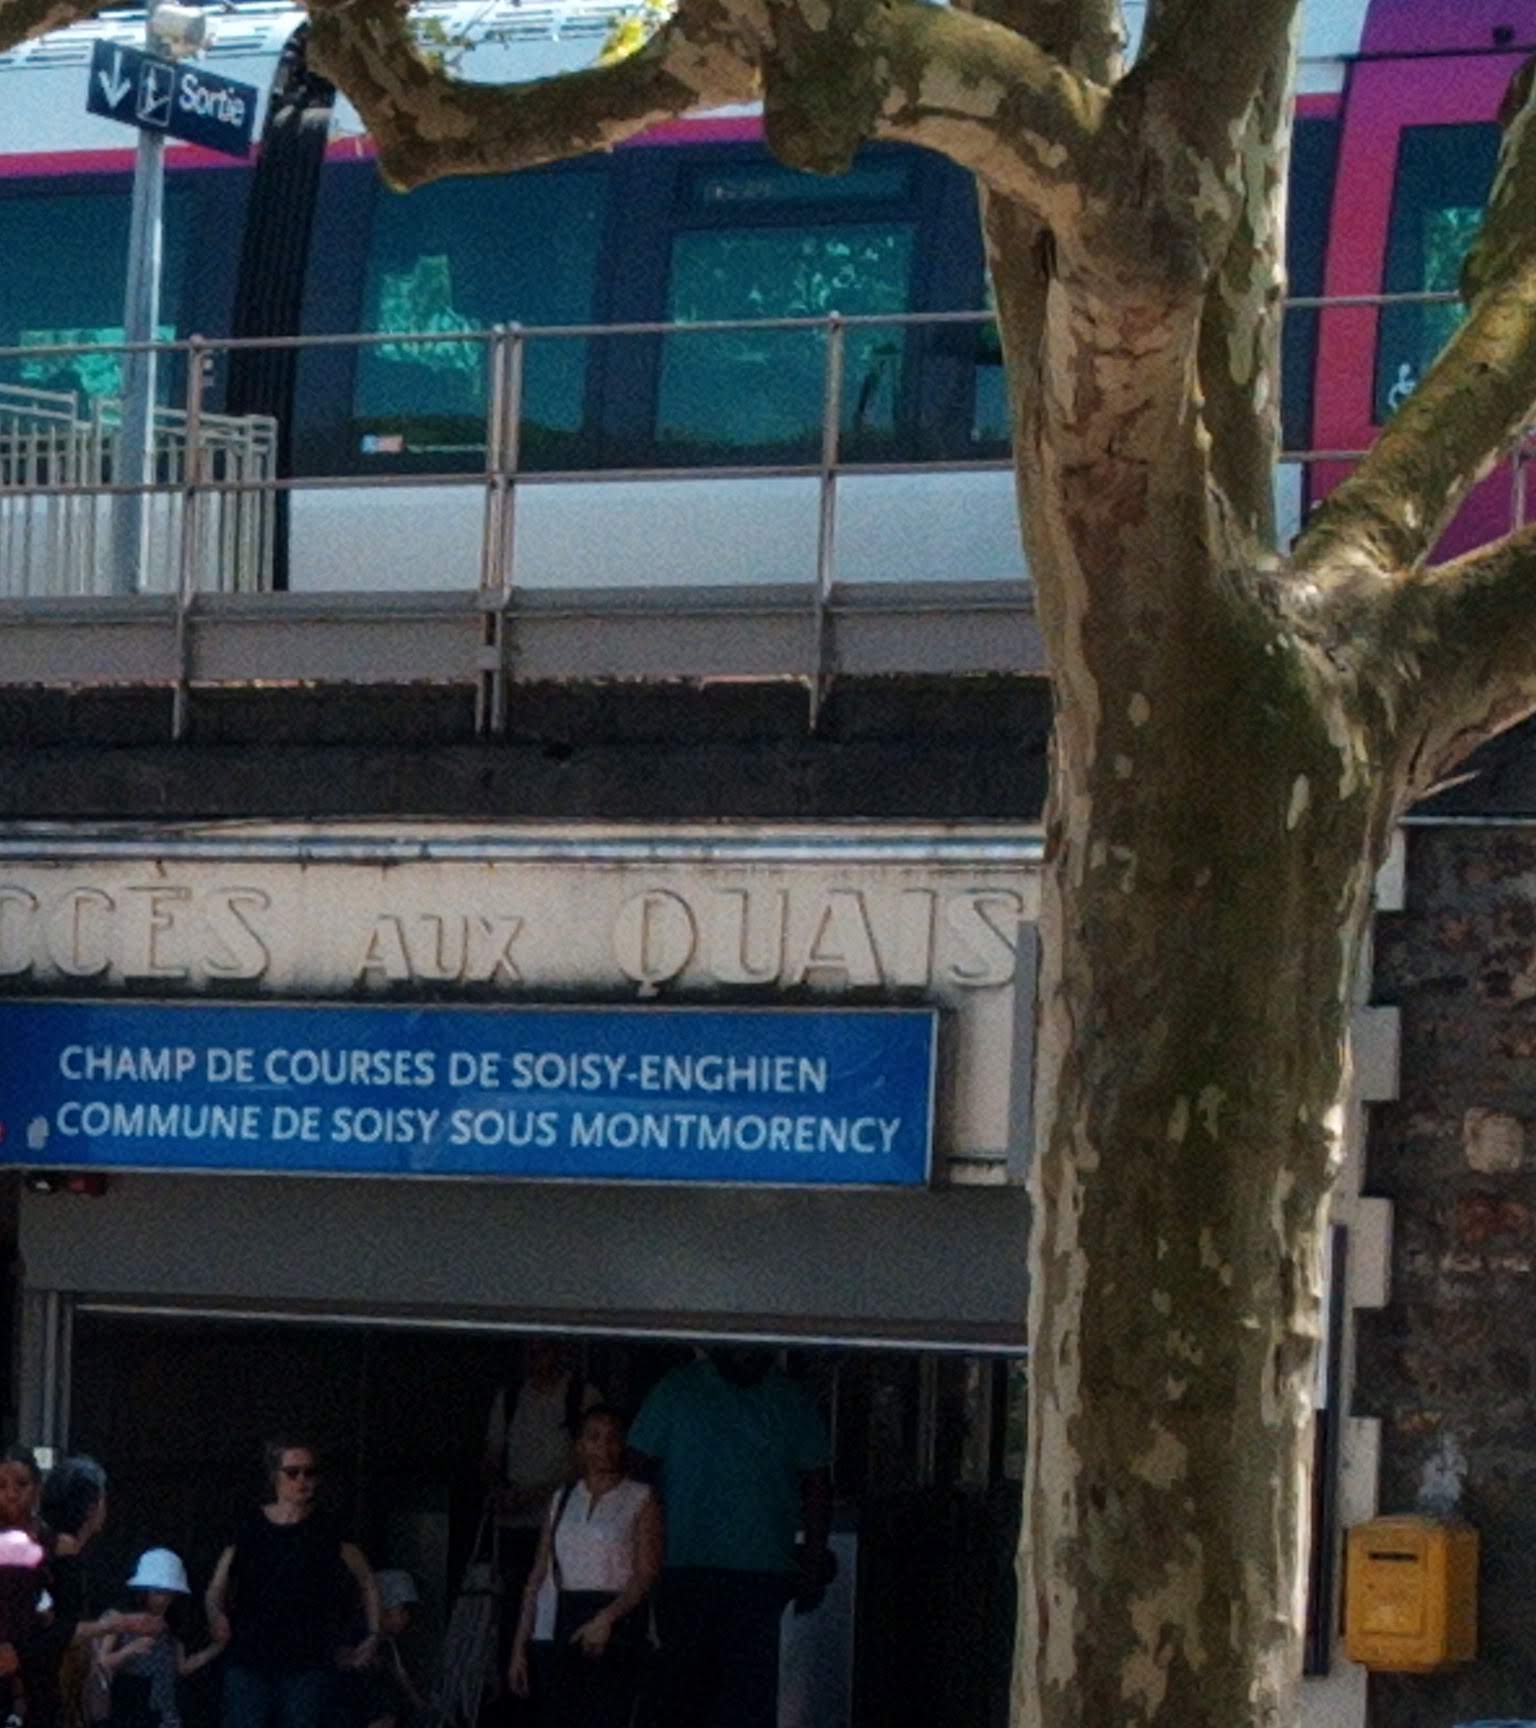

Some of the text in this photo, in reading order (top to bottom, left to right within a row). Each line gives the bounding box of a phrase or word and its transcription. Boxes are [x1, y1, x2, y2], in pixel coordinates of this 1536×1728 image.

[180, 73, 245, 127] Sortie
[355, 912, 525, 982] AUX
[616, 887, 1024, 997] QUAIS
[59, 1045, 827, 1092] CHAMP DE COURSES DE SOISY-ENGHIEN
[57, 1101, 902, 1154] COMMUNE DE SOISY SOUS MONTMORENCY
